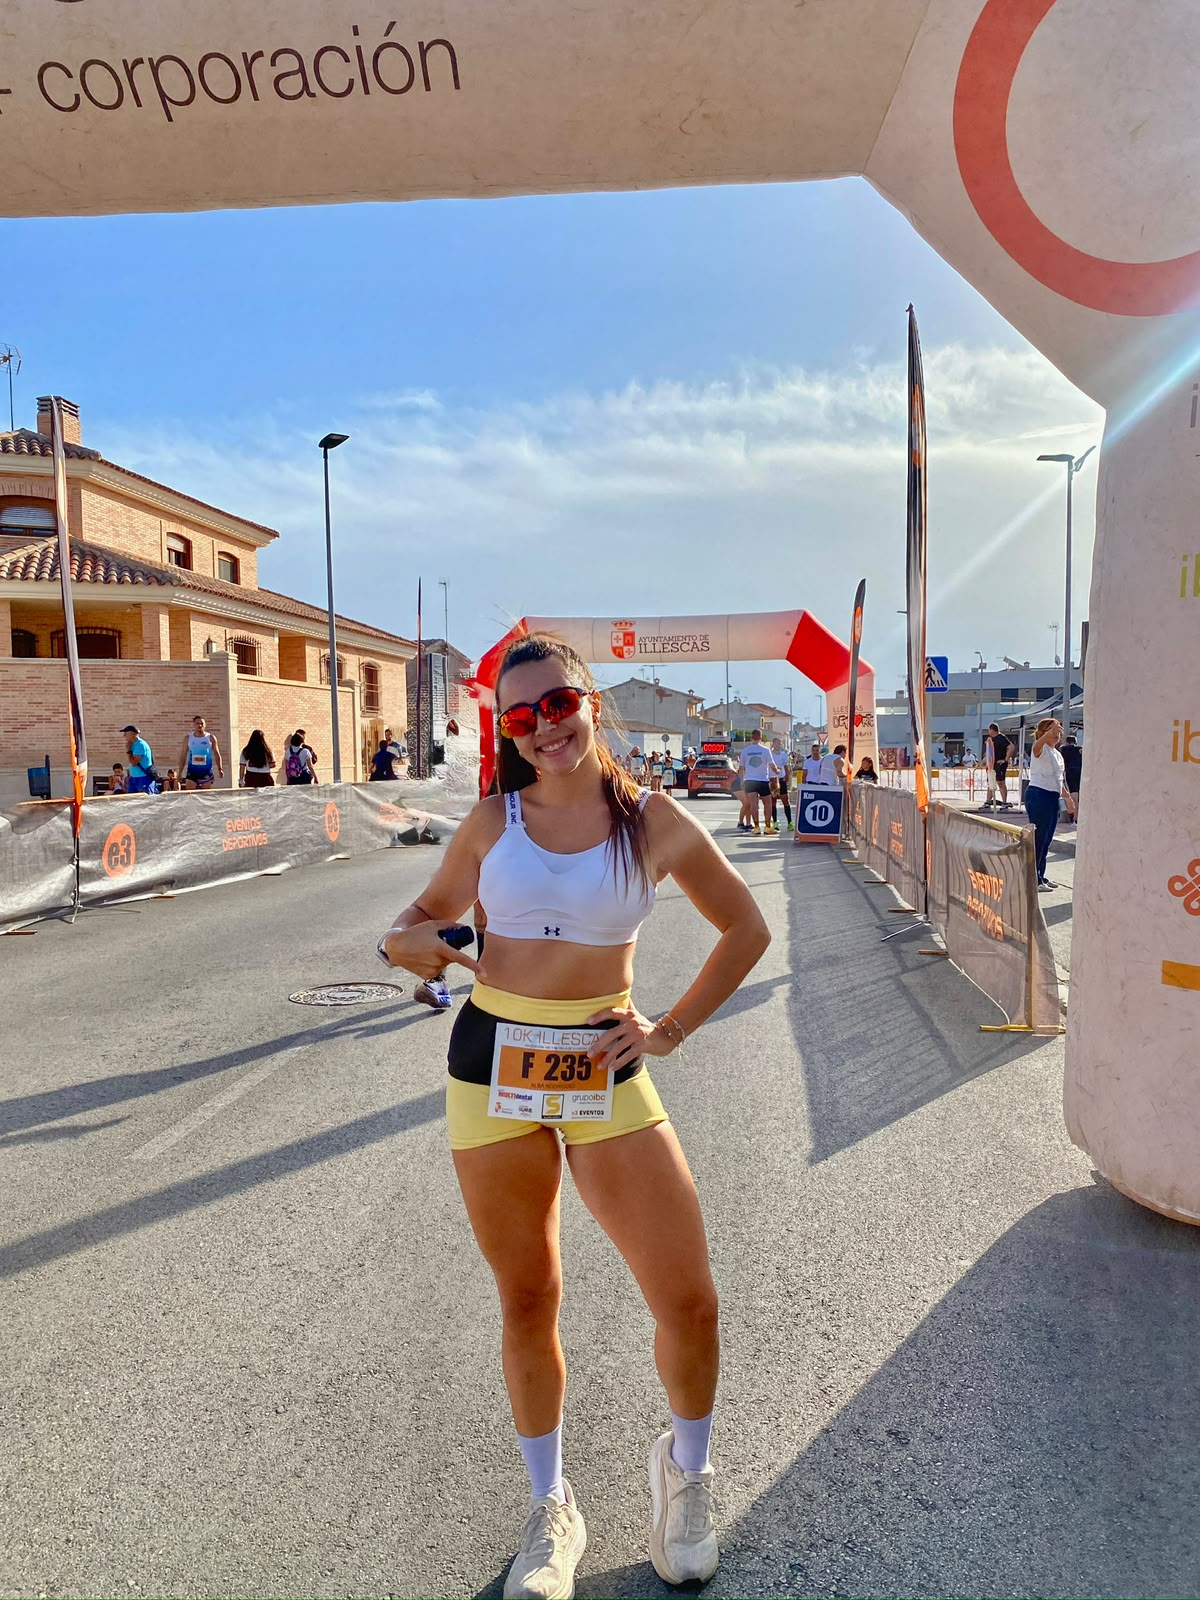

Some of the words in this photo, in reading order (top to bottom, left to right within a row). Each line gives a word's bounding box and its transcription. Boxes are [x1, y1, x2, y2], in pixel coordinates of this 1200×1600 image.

[37, 21, 461, 122] corporación
[638, 634, 698, 643] AYUNTAMIENTO
[638, 641, 710, 654] ILLESCAS
[810, 804, 829, 821] 10
[225, 816, 262, 833] EVENTOS
[222, 833, 268, 851] DEPORTIVOS
[108, 834, 132, 869] e3
[504, 1027, 533, 1042] 10K
[536, 1031, 600, 1046] ILLESCA
[521, 1052, 535, 1079] F
[543, 1053, 592, 1082] 235
